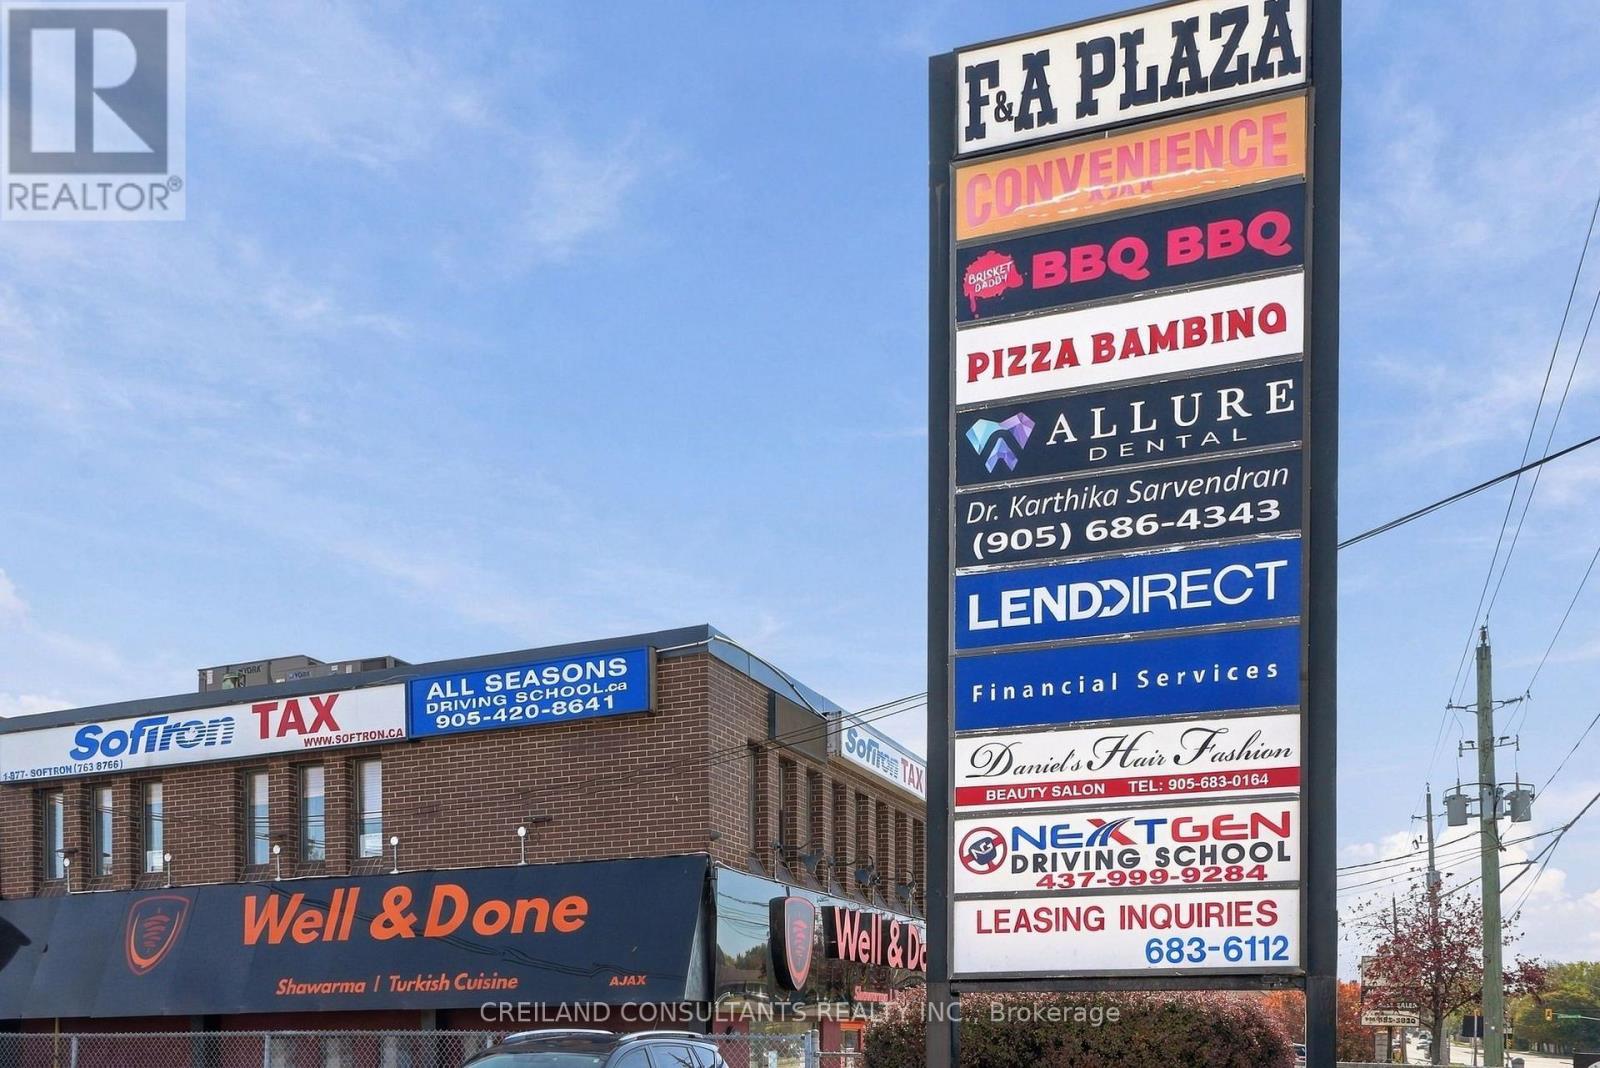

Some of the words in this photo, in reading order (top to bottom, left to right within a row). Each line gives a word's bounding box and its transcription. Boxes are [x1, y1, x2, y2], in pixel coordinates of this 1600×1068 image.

[965, 49, 1058, 142] F&A
[1076, 0, 1301, 119] PLAZA
[966, 112, 1288, 228] CONVENIENCE
[1032, 236, 1151, 289] BBQ
[1167, 209, 1293, 266] BBQ
[969, 260, 1014, 285] BRISKET
[967, 338, 1082, 383] PIZZA
[1046, 379, 1295, 445] ALLURE
[1089, 428, 1247, 461] DENTAL
[966, 501, 999, 524] Dr.
[1009, 485, 1118, 519] Karthika
[1126, 465, 1289, 503] Sarvendran
[973, 523, 1072, 559] (905)
[1085, 499, 1281, 542] 686-4343
[427, 678, 474, 700] ALL
[485, 658, 627, 693] SEASONS
[973, 672, 1117, 703] Financial
[1138, 662, 1278, 689] Services
[426, 695, 507, 714] DRIVING
[515, 682, 627, 703] SCHOOL.ca
[436, 695, 614, 729] 905-420-8641
[251, 694, 341, 740] TAX
[303, 728, 404, 748] WWW.SOFTRON.CA
[965, 742, 1083, 778] Daniel's
[1087, 730, 1166, 770] Hair
[1174, 727, 1292, 765] Fashion
[30, 765, 72, 777] SOFTRON
[901, 758, 923, 793] TAX
[986, 786, 1047, 801] BEAUTY
[1052, 783, 1105, 798] SALON
[1128, 780, 1163, 793] TEL:
[1168, 773, 1269, 791] 905-683-0164
[1011, 848, 1141, 874] DRIVING
[1156, 841, 1290, 867] SCHOOL
[1036, 865, 1268, 889] 437-999-9284
[242, 887, 360, 945] Well
[424, 884, 588, 937] Done
[976, 906, 1105, 934] LEASING
[1120, 900, 1278, 930] INQUIRIES
[834, 907, 882, 966] Well
[888, 919, 903, 969] &
[1145, 935, 1289, 964] 683-6112
[275, 978, 366, 996] Shawarma
[389, 973, 449, 994] Turkish
[453, 971, 518, 991] Cuisine
[609, 975, 647, 987] AJAX
